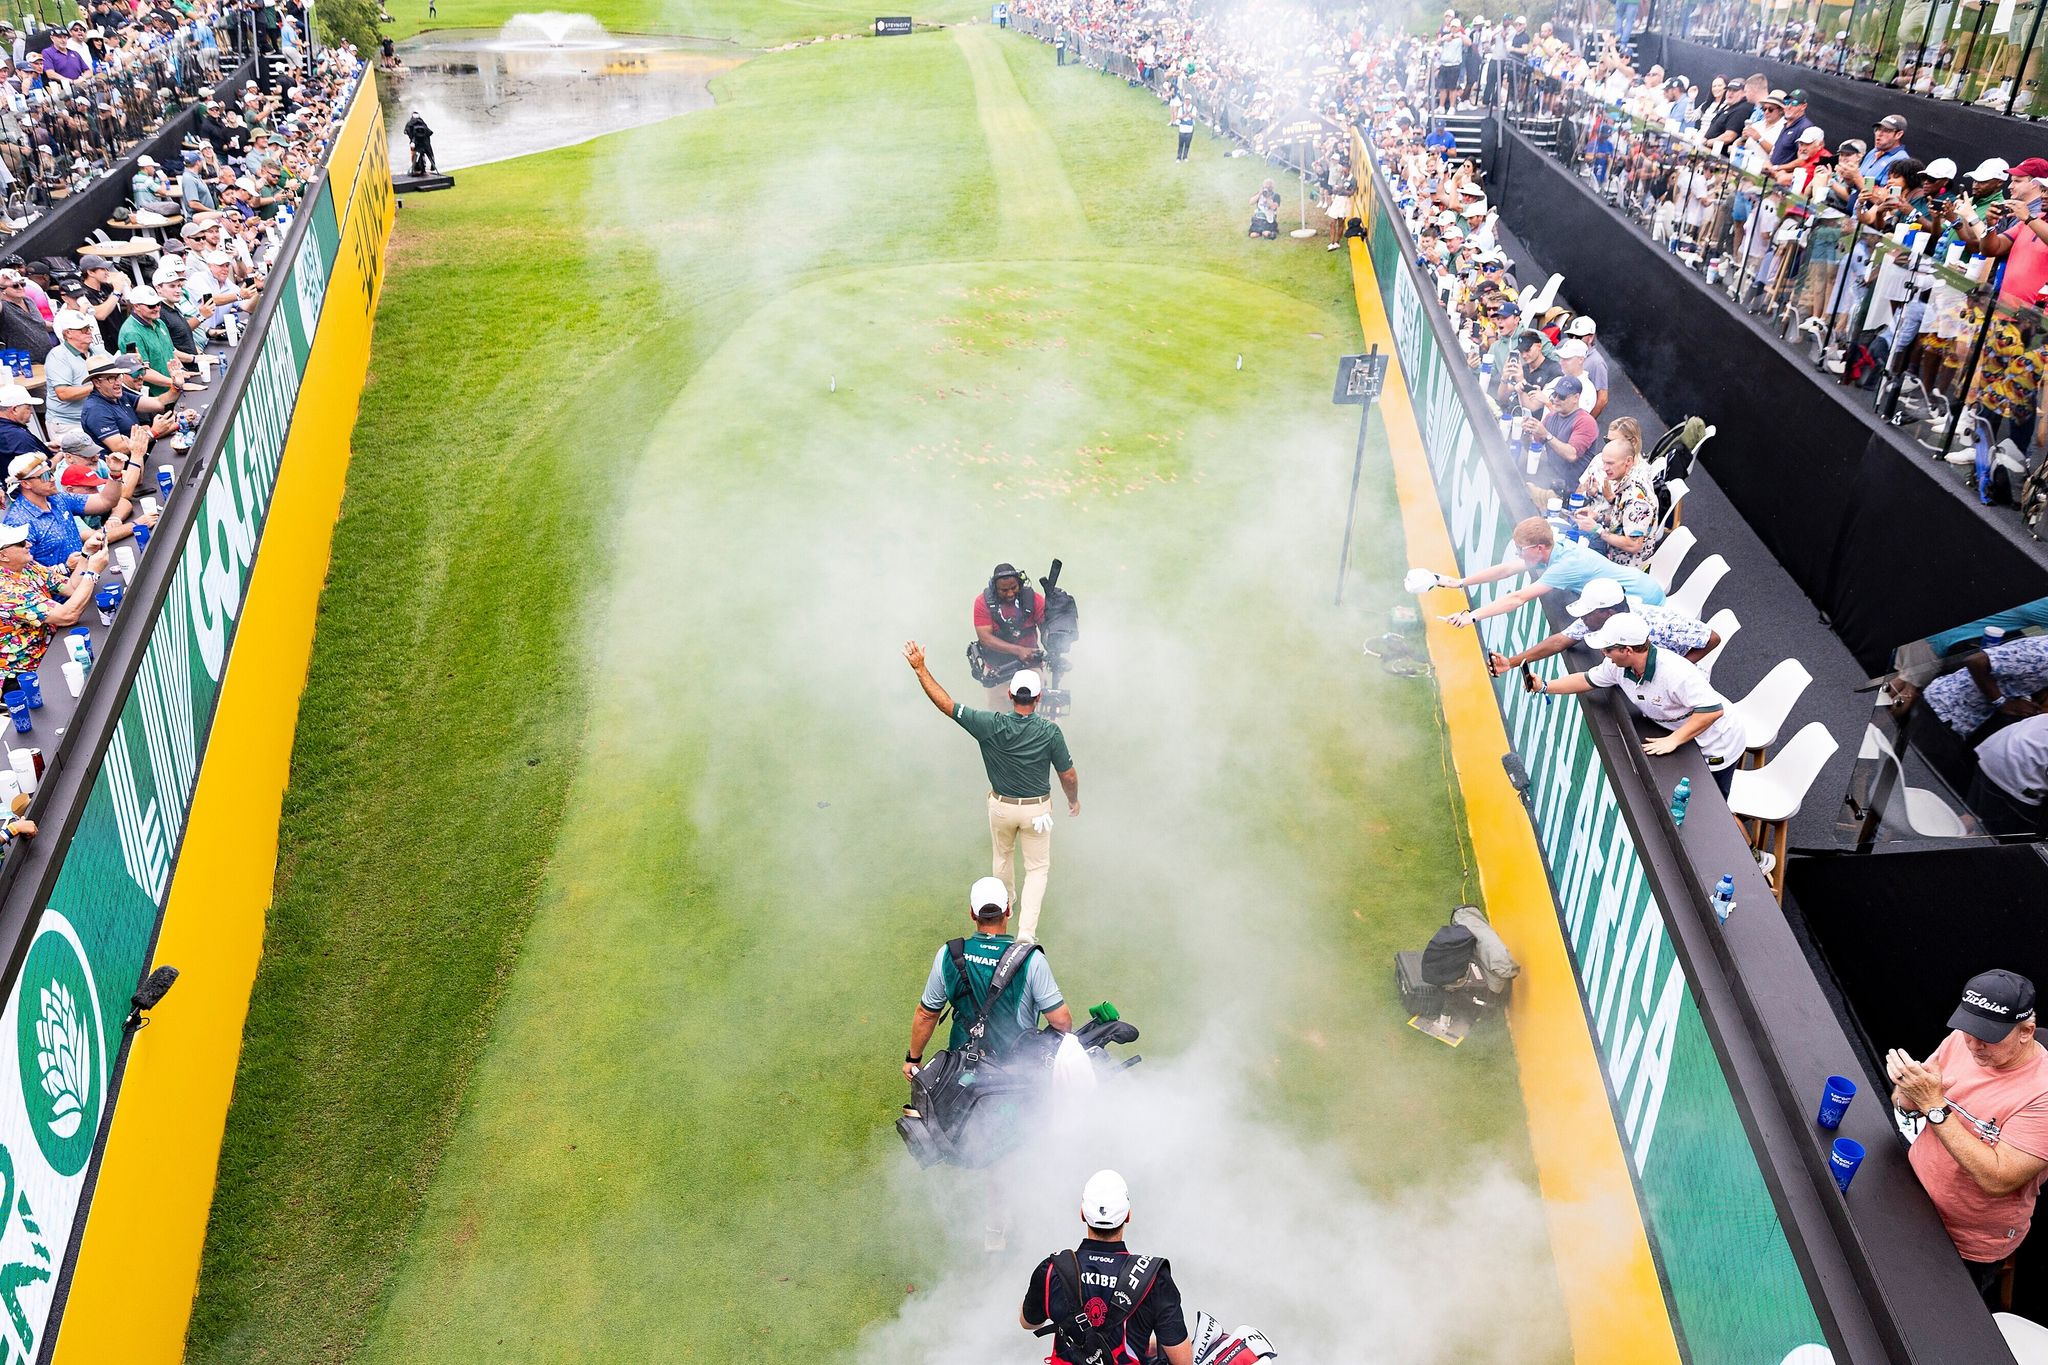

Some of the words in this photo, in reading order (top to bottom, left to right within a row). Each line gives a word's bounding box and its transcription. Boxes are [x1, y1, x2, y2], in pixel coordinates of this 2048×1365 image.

[103, 556, 196, 906] LIV
[183, 411, 257, 682] GOLF
[1426, 336, 1465, 485] LIV
[1560, 744, 1686, 1177] AFRICA
[1962, 989, 2010, 1014] Titleist
[2015, 1011, 2029, 1020] PRO
